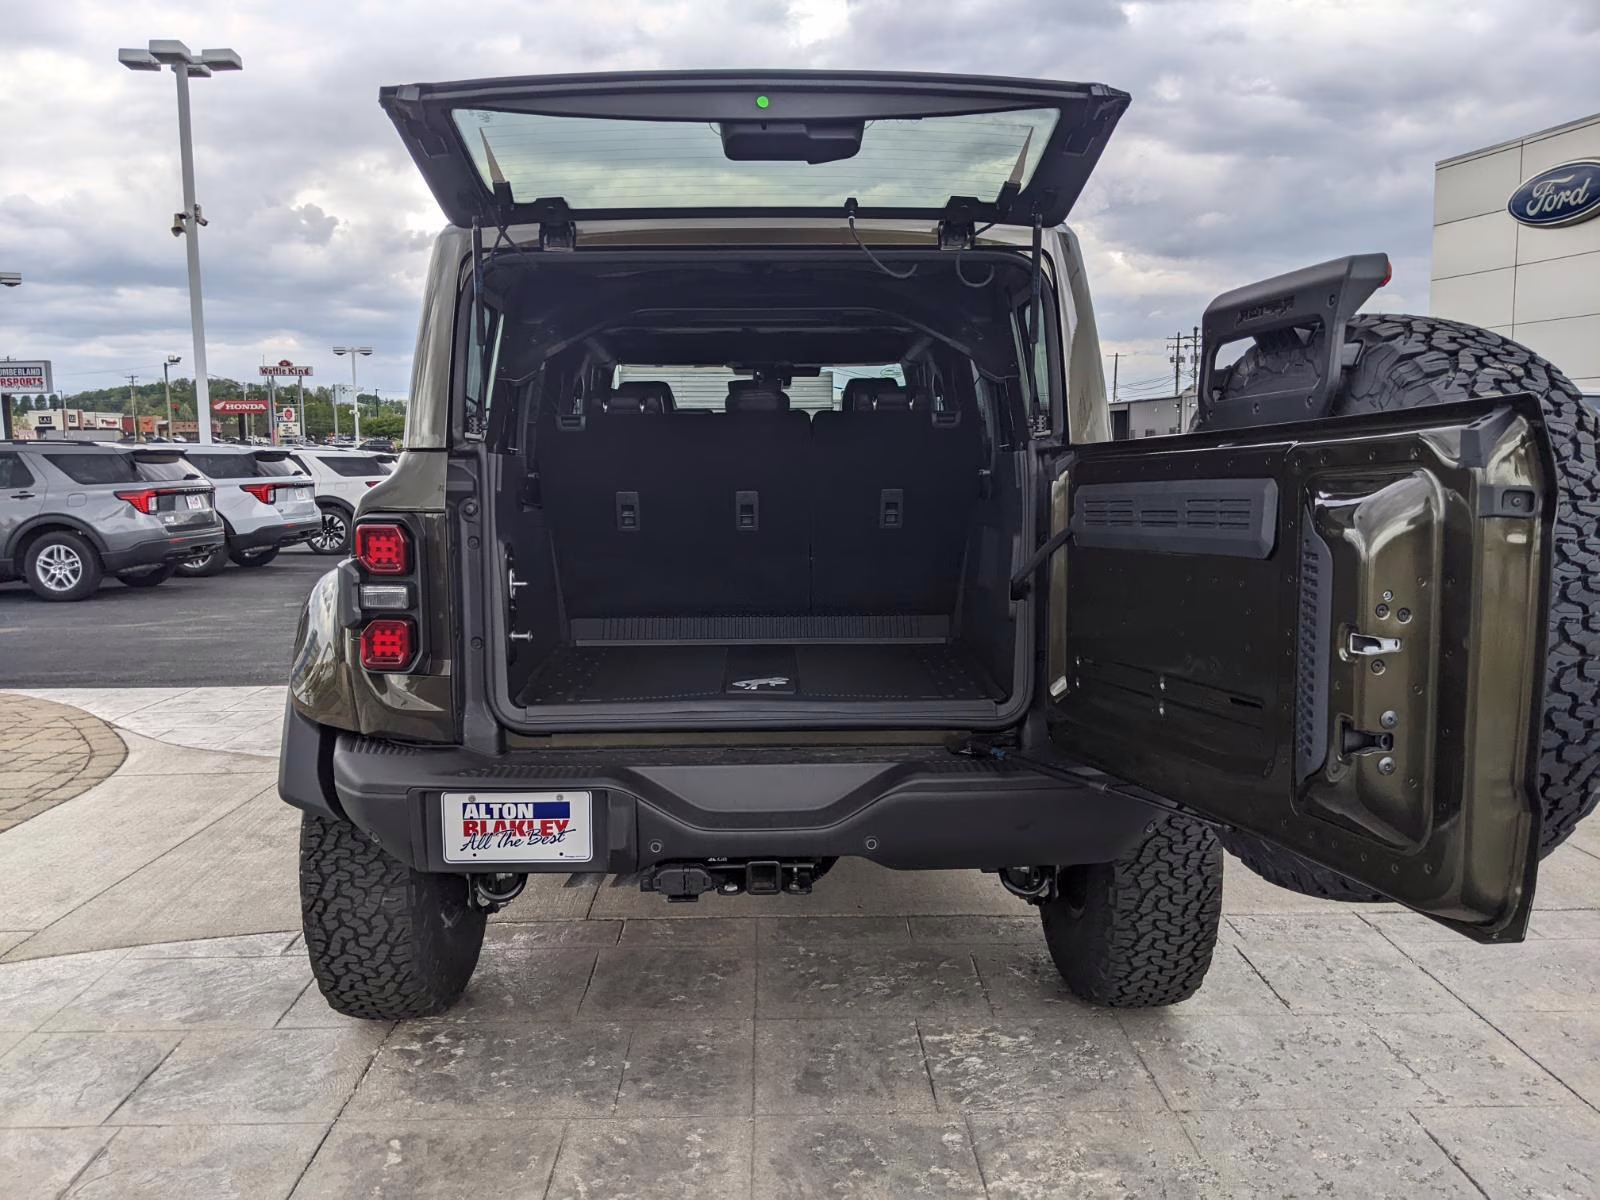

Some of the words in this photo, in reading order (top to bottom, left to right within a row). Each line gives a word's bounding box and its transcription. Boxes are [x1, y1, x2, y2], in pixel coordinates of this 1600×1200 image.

[1526, 174, 1592, 216] Ford
[260, 367, 287, 375] Waffle
[288, 367, 309, 375] King
[463, 803, 534, 819] ALTON
[463, 819, 570, 838] BLAKLEY
[460, 831, 492, 852] All
[495, 829, 524, 849] The
[525, 828, 577, 846] Best
